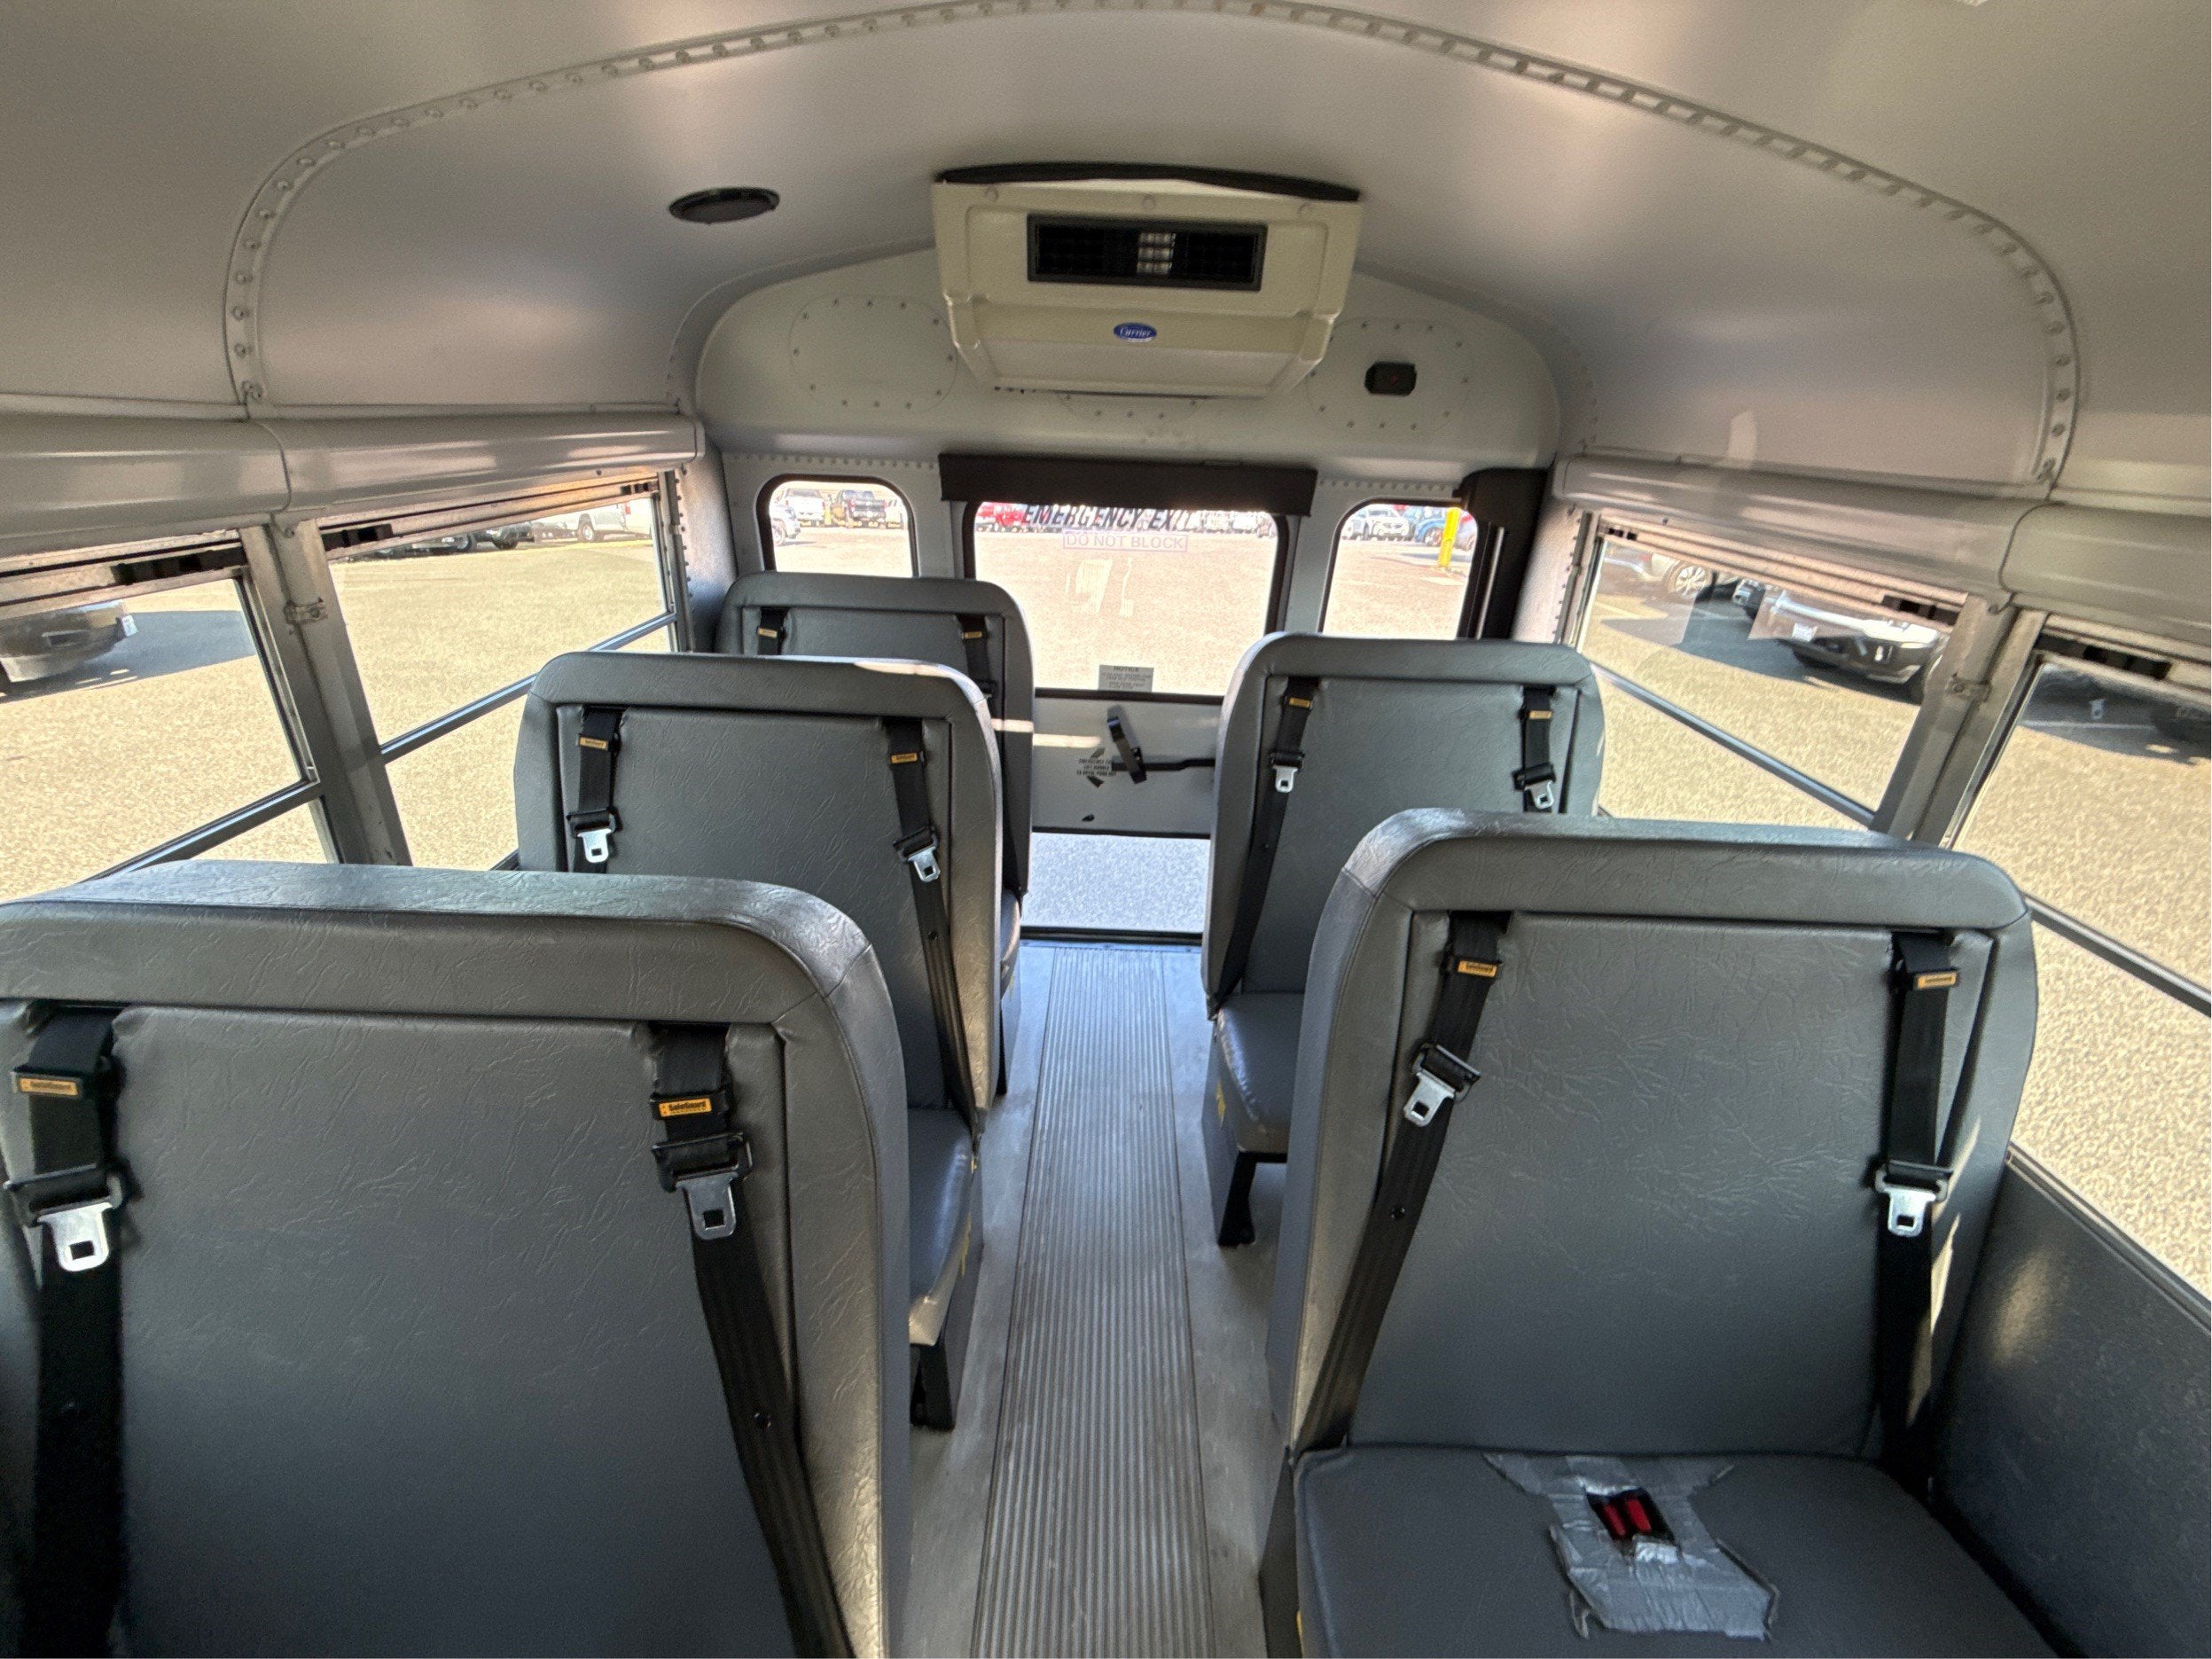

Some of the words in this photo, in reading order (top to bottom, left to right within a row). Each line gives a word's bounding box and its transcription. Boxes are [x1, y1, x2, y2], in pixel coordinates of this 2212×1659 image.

[1022, 505, 1144, 528] EMERGENCY
[1067, 535, 1089, 546] DO
[1093, 535, 1128, 547] NOT
[1130, 536, 1184, 549] BLOCK
